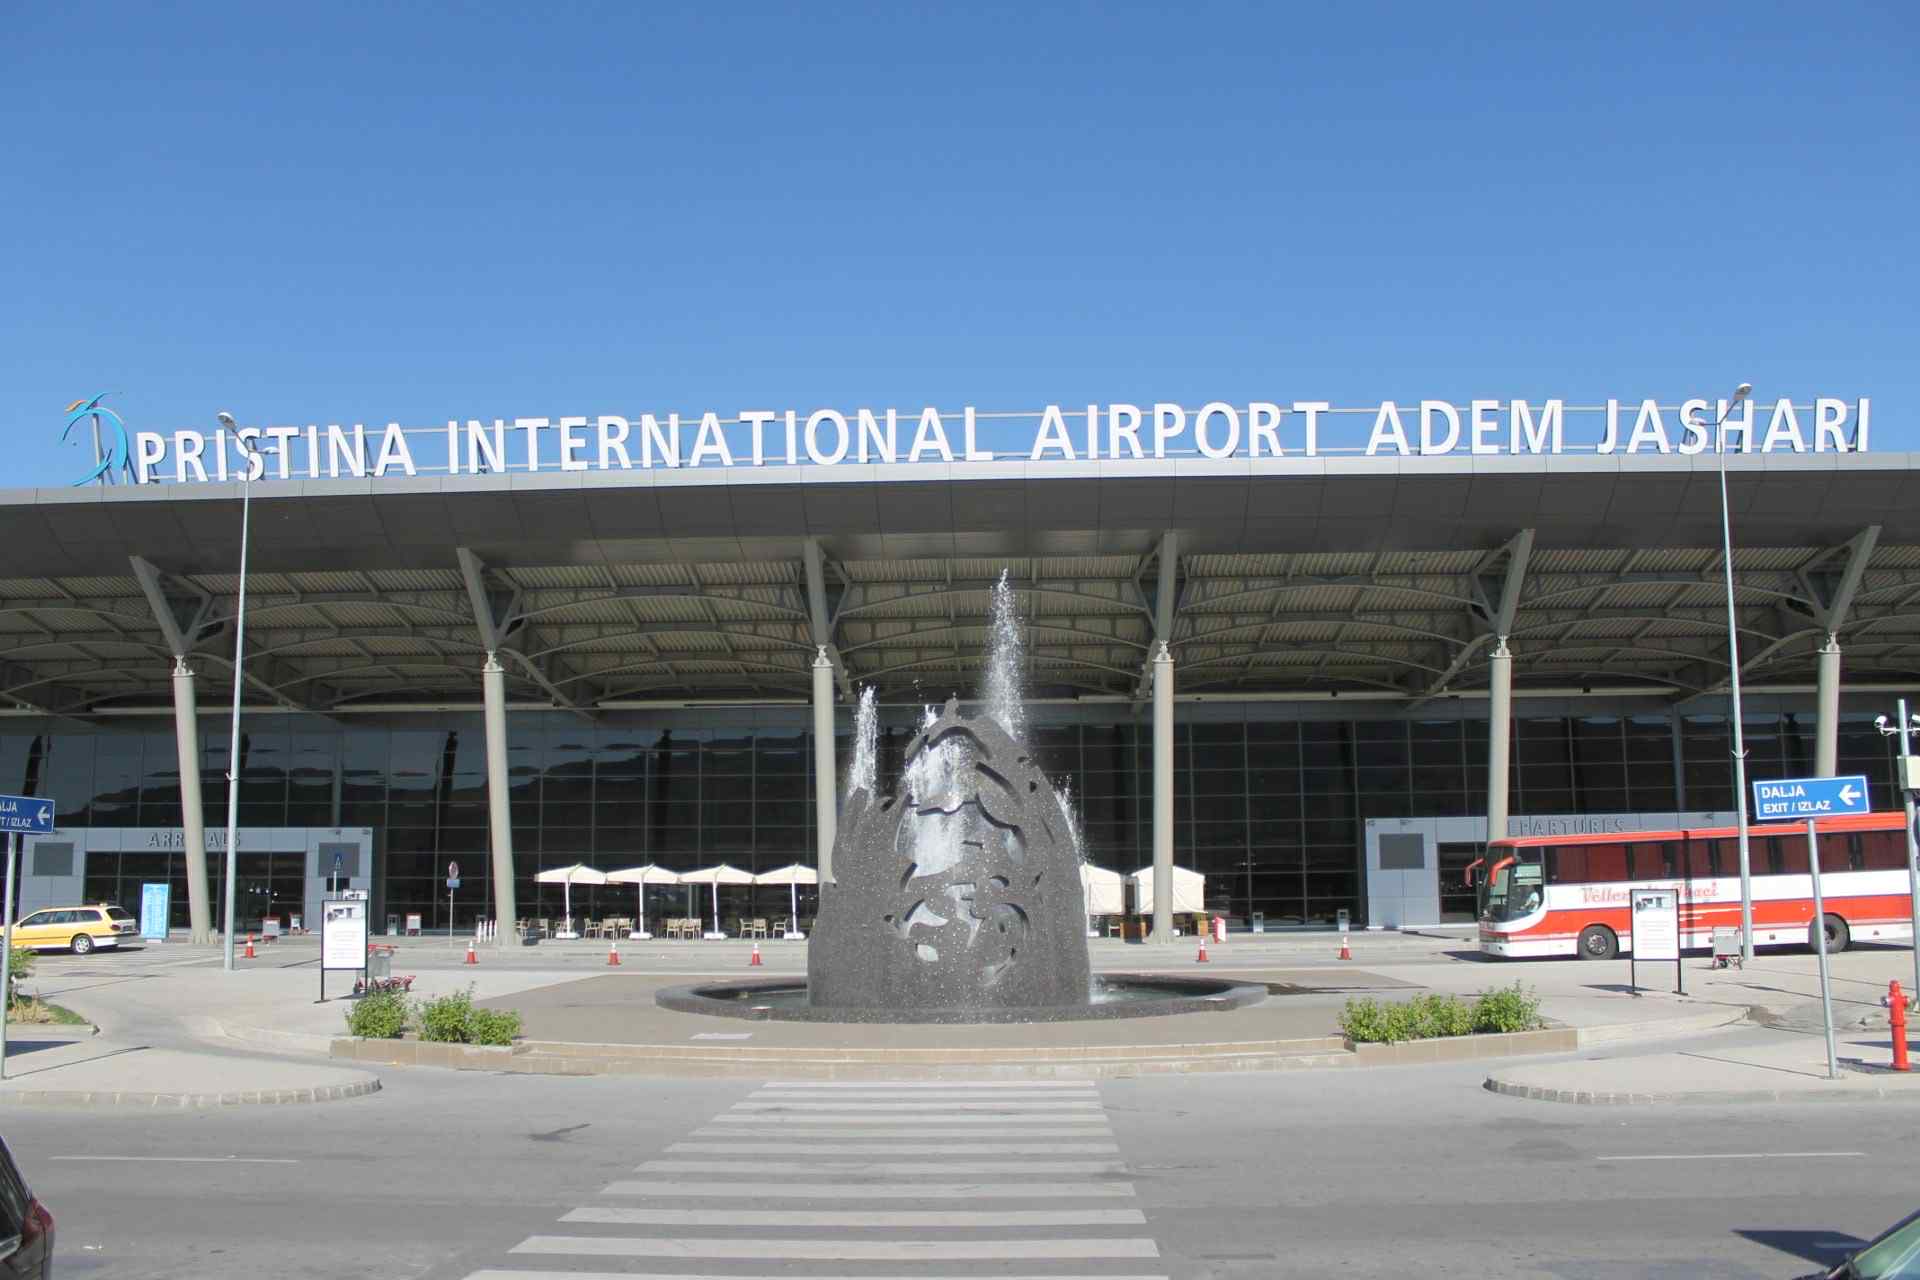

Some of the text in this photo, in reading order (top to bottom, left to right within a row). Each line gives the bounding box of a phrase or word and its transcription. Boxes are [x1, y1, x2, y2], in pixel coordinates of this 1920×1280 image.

[137, 398, 1870, 484] PRISTINA INTERNATIONAL AIRPORT ADEM JASHARI
[1761, 785, 1806, 799] DALJA
[1763, 802, 1789, 813] EXIT
[1798, 800, 1832, 811] IZLAZ
